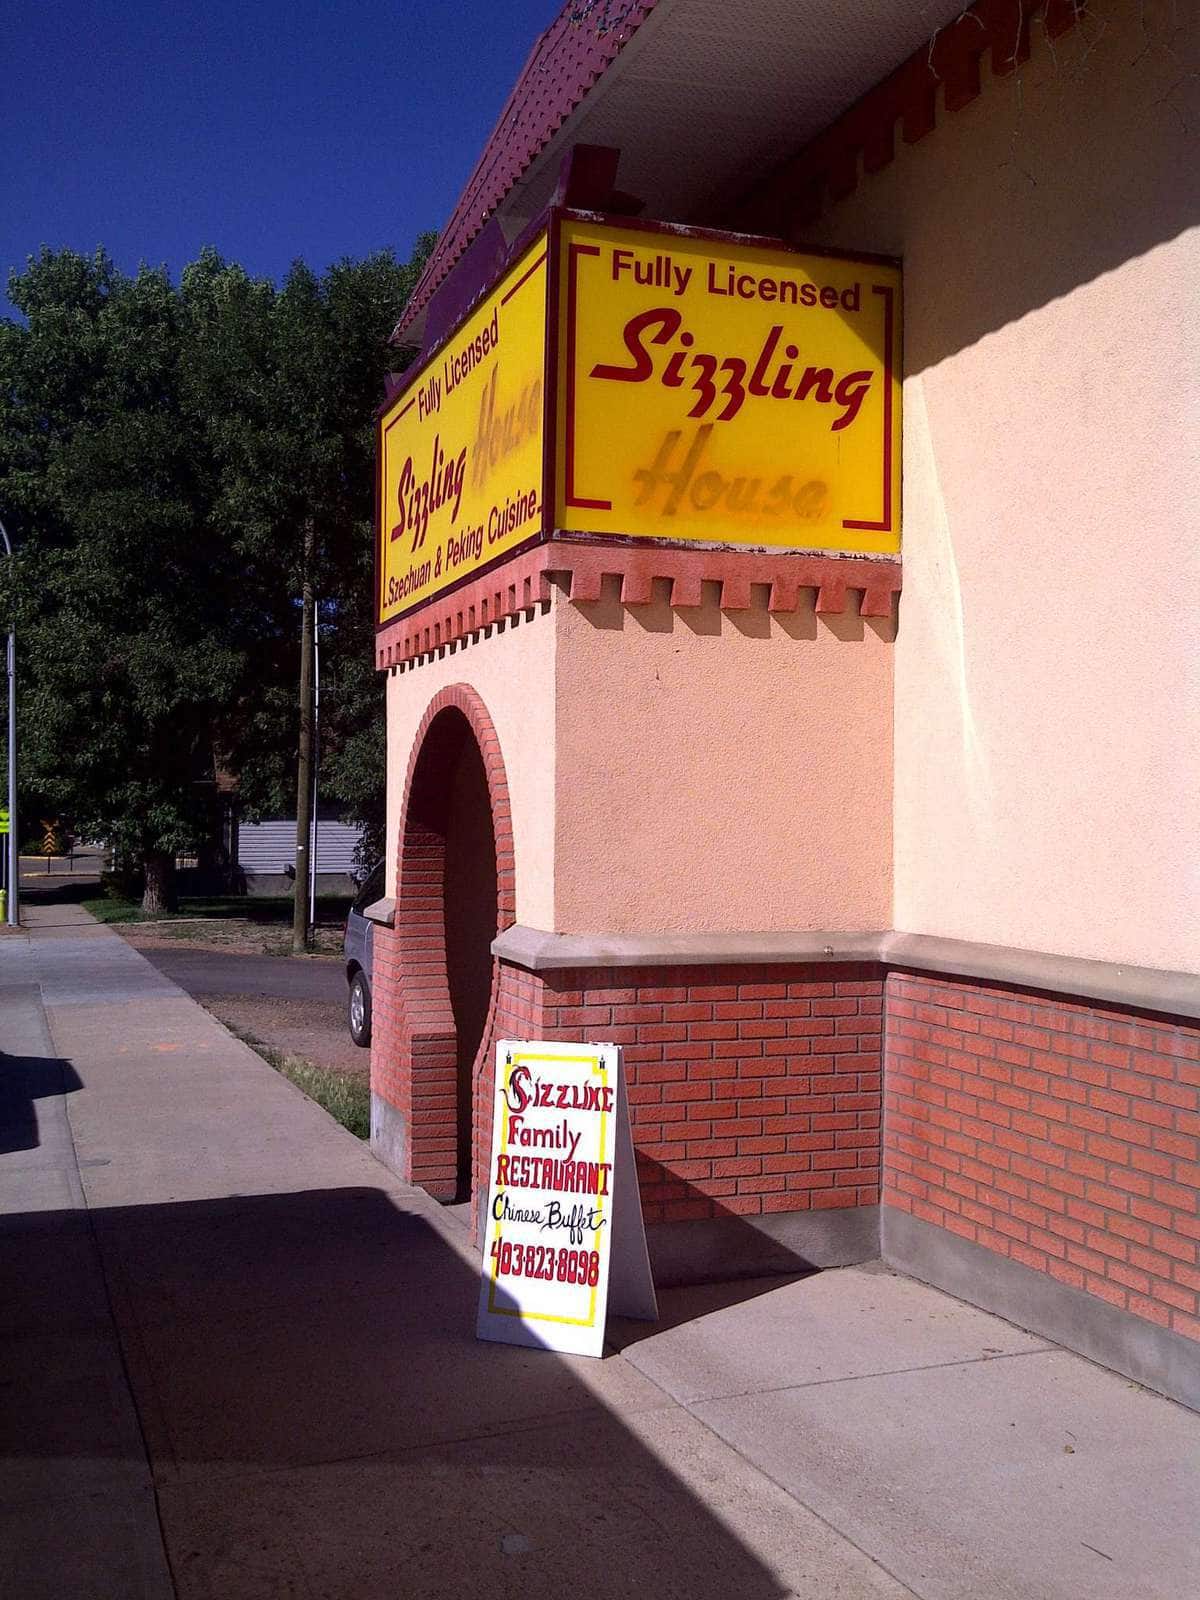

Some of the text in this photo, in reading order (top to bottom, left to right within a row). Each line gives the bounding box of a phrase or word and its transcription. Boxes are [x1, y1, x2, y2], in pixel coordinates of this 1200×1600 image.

[612, 249, 862, 312] Fully Licensed
[417, 307, 499, 423] Fully Licensed
[589, 307, 875, 431] Sizzling
[390, 433, 467, 552] Sizzling
[632, 422, 829, 517] House
[388, 489, 537, 607] Szechuan & Peking Cuisine
[495, 1154, 612, 1196] RESTAURANT
[507, 1115, 582, 1164] Family
[492, 1191, 608, 1245] Chinese Buffet
